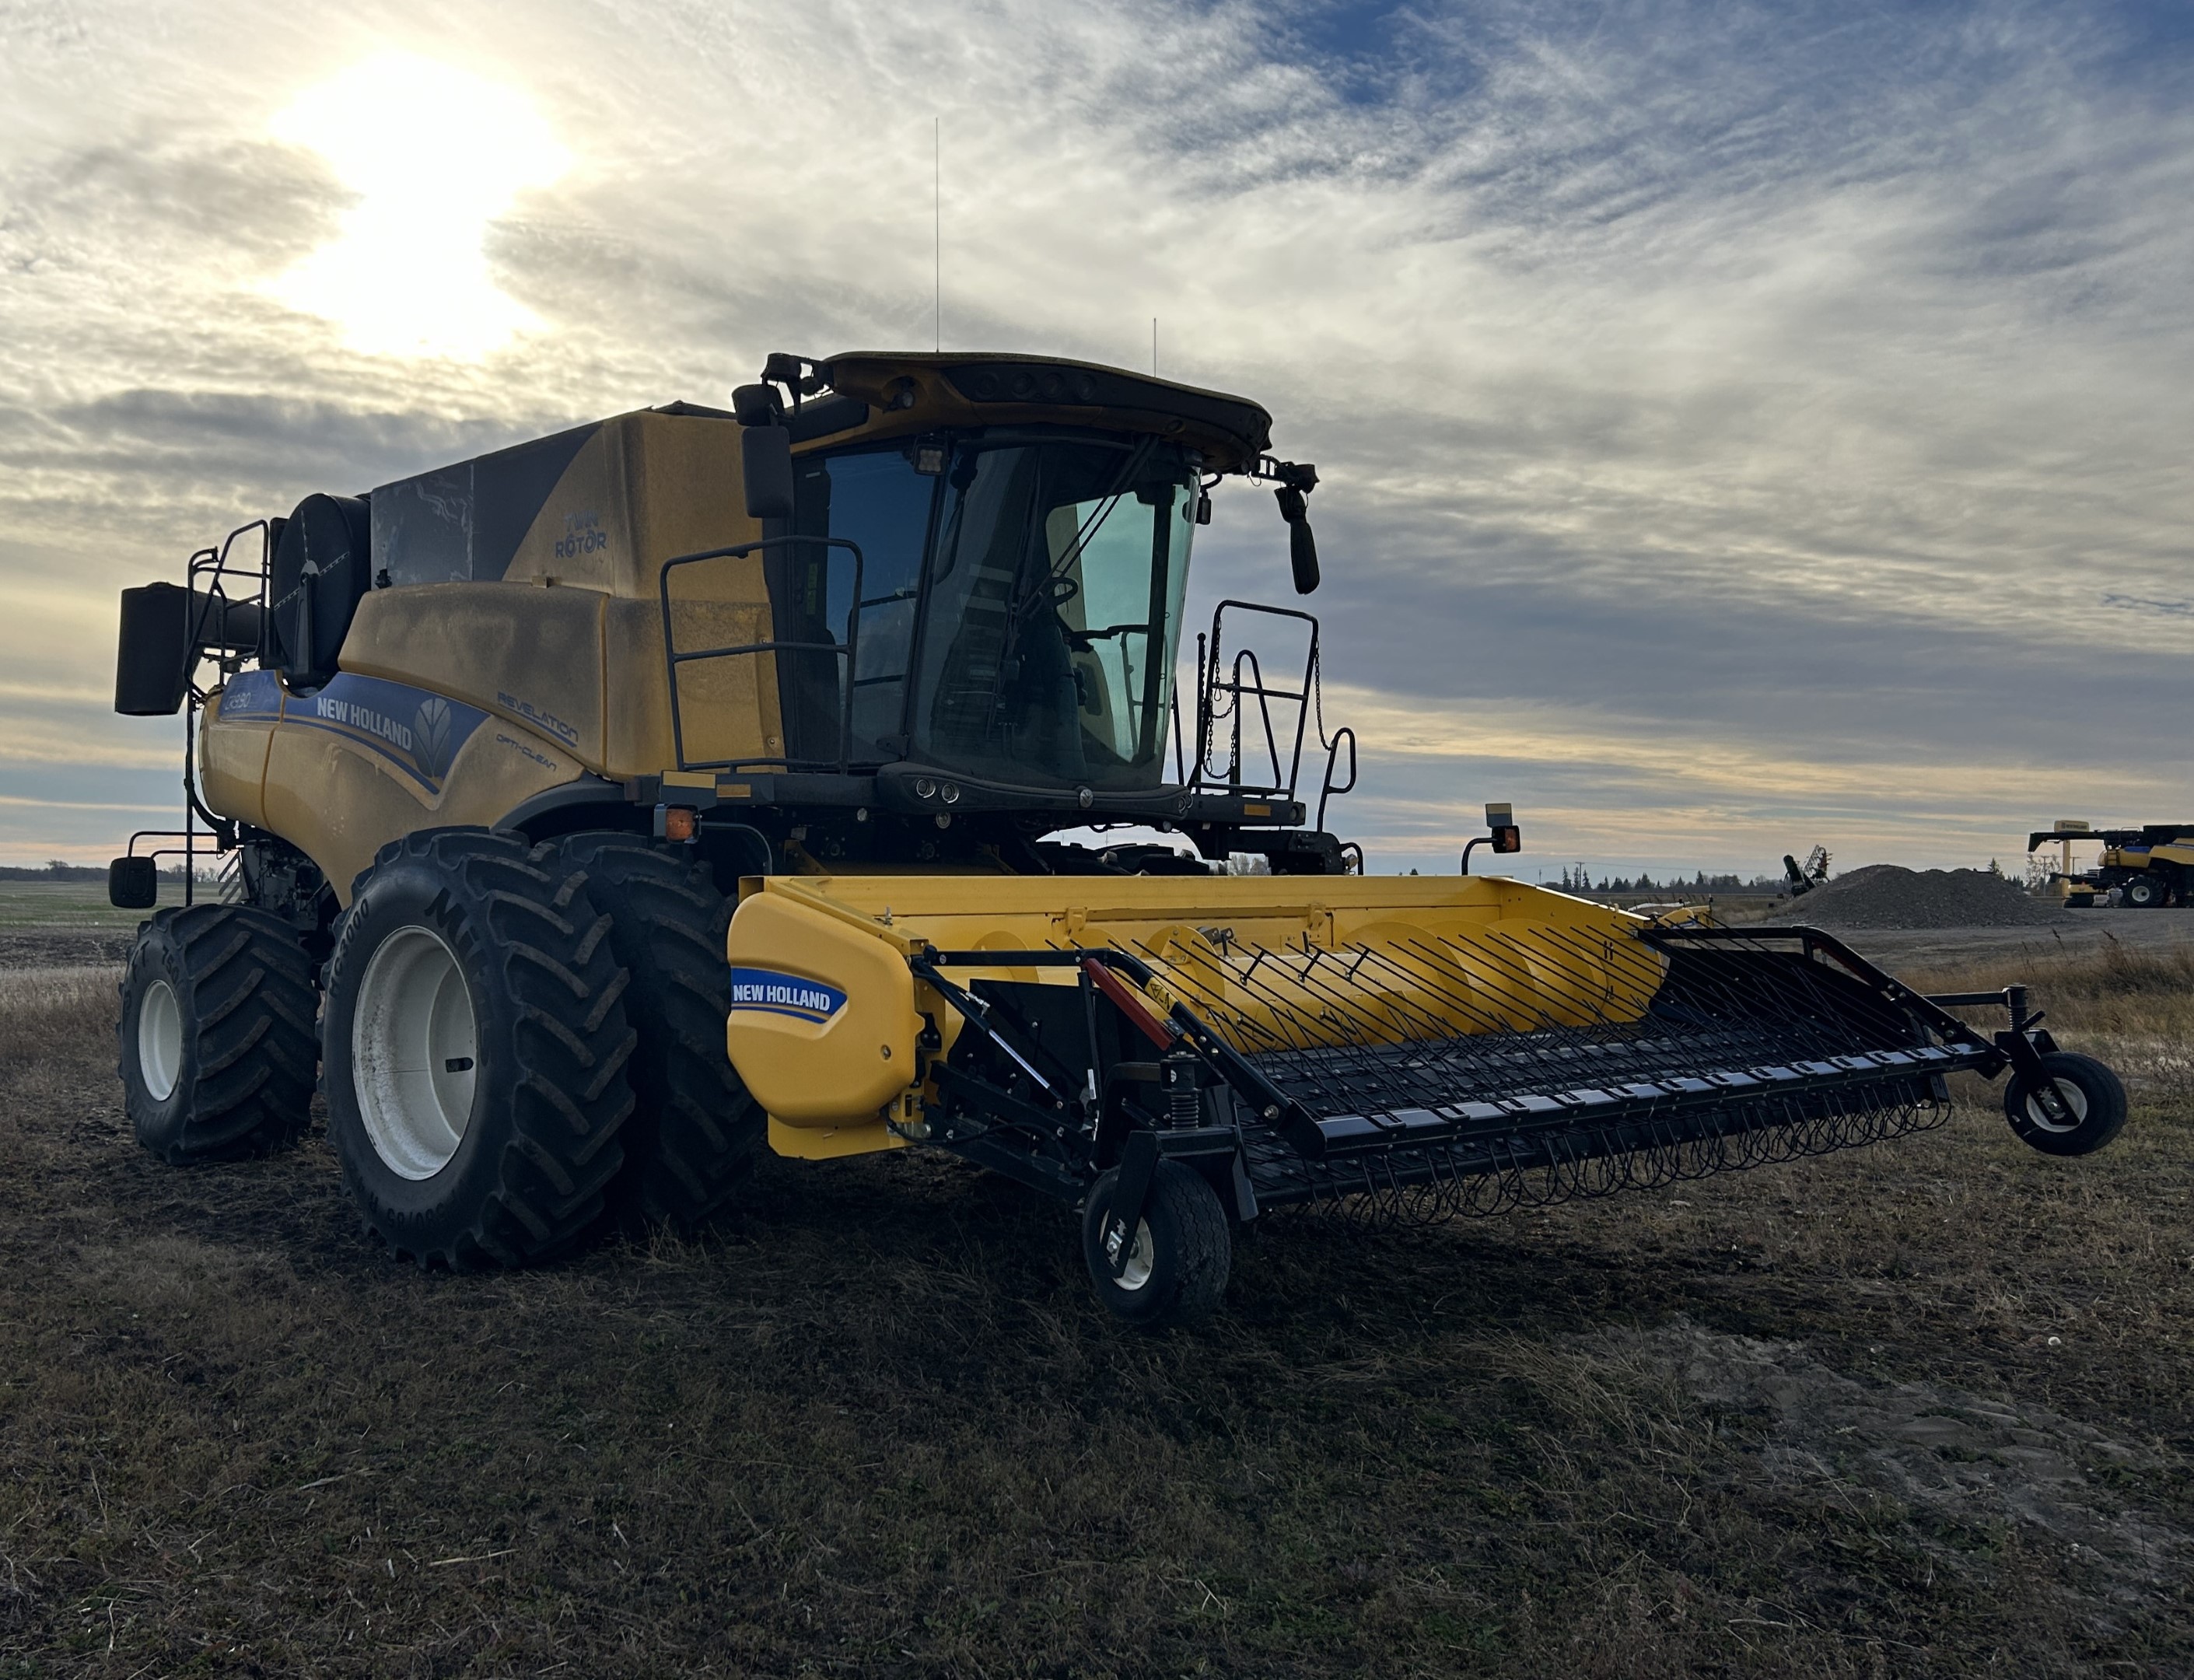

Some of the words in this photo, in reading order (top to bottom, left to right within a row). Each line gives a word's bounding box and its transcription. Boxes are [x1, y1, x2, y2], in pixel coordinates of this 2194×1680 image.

[563, 509, 599, 533] TWIN
[555, 530, 607, 558] ROTOR
[317, 697, 348, 722] NEW
[351, 704, 412, 751] HOLLAND
[497, 691, 579, 743] REVELATION
[496, 733, 557, 772] OPTI-CLEAN
[733, 984, 765, 1002] NEW
[766, 985, 831, 1011] HOLLAND
